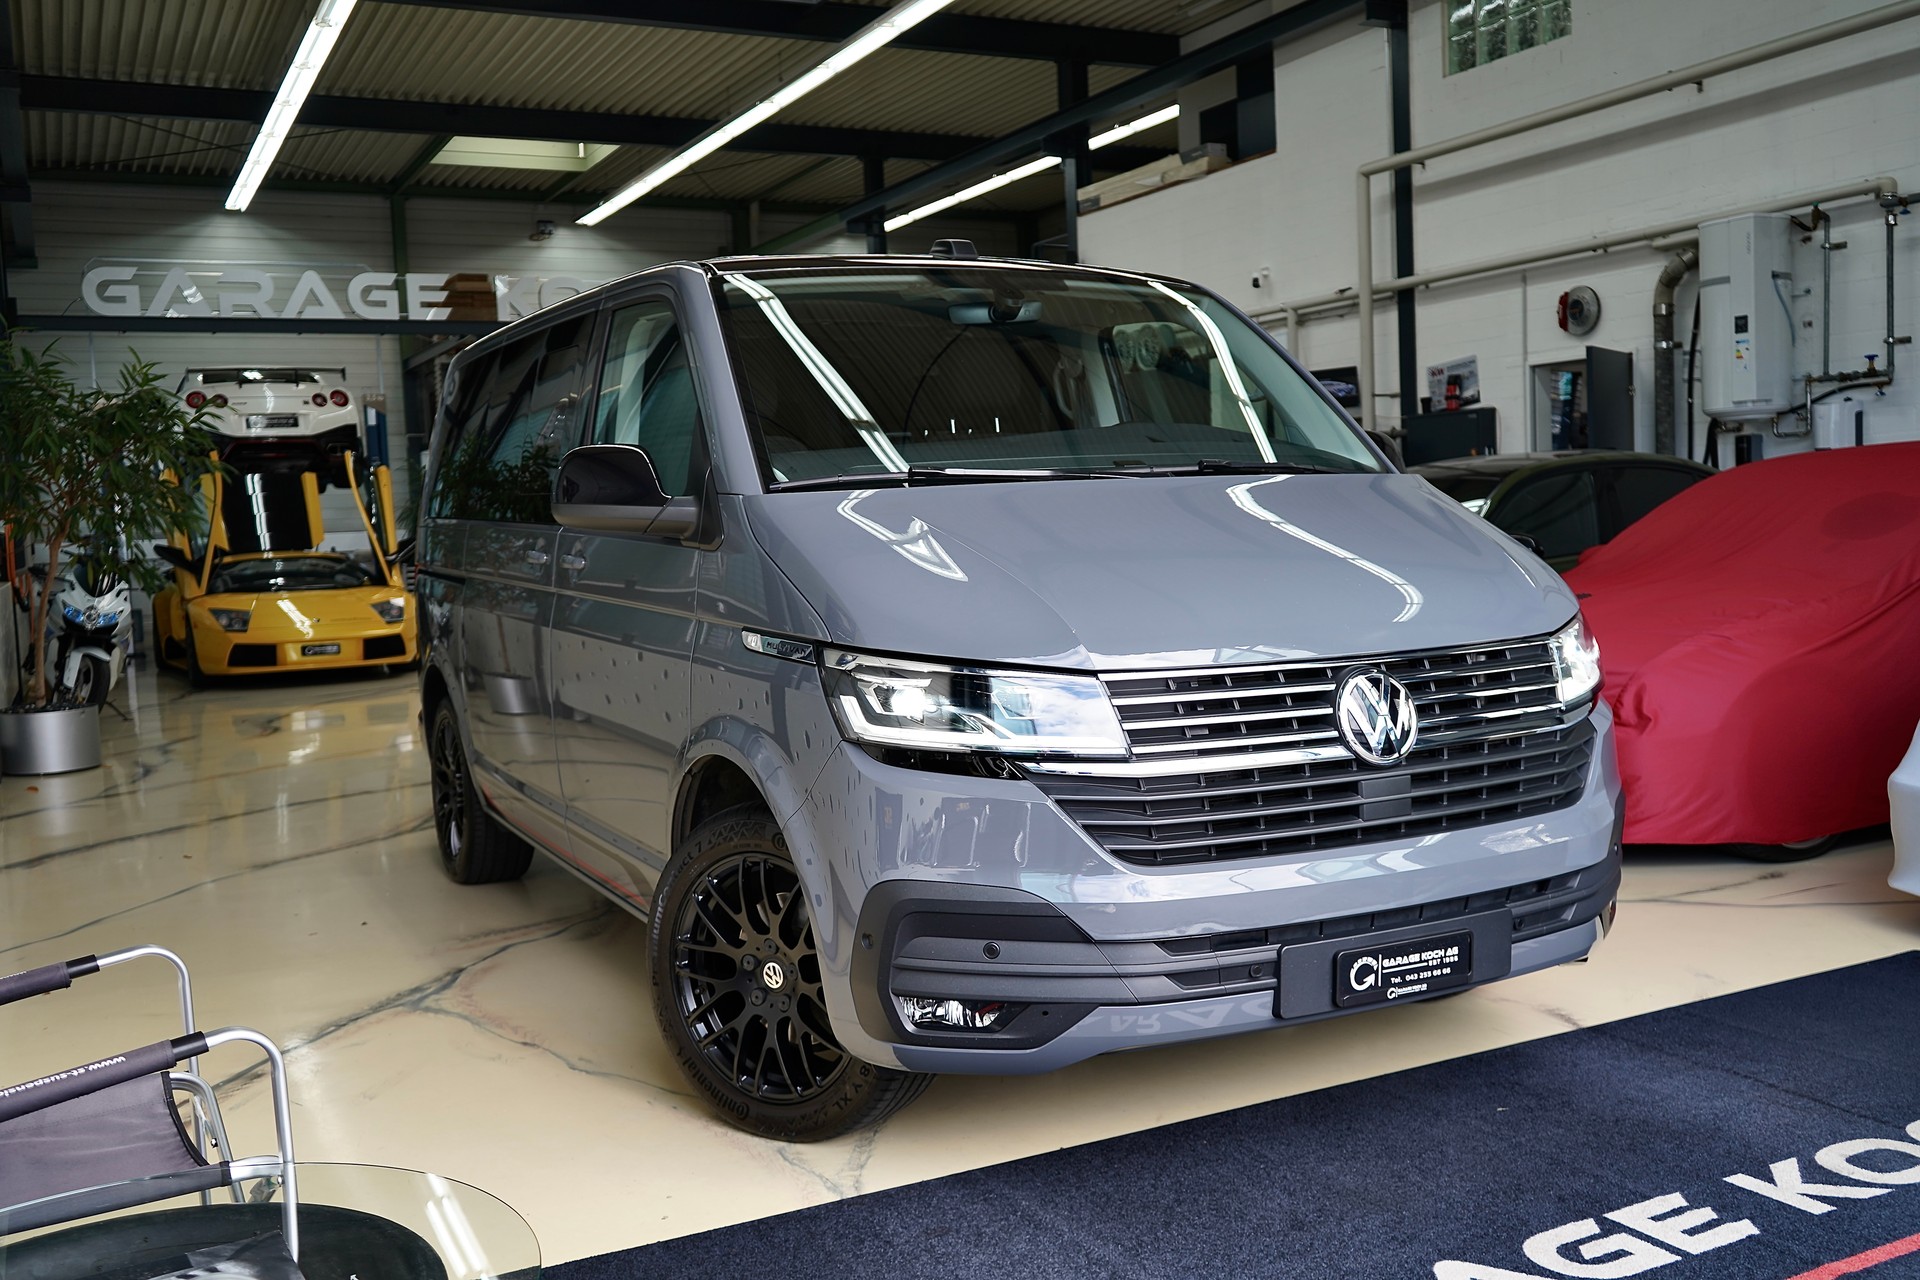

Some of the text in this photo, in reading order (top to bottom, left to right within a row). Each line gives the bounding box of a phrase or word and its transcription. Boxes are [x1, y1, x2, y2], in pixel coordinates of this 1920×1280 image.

[82, 267, 453, 321] GARAGE
[1382, 946, 1459, 967] GARAGE KOCH AG
[1390, 976, 1403, 984] Tel.
[1434, 1119, 1920, 1280] GE KO
